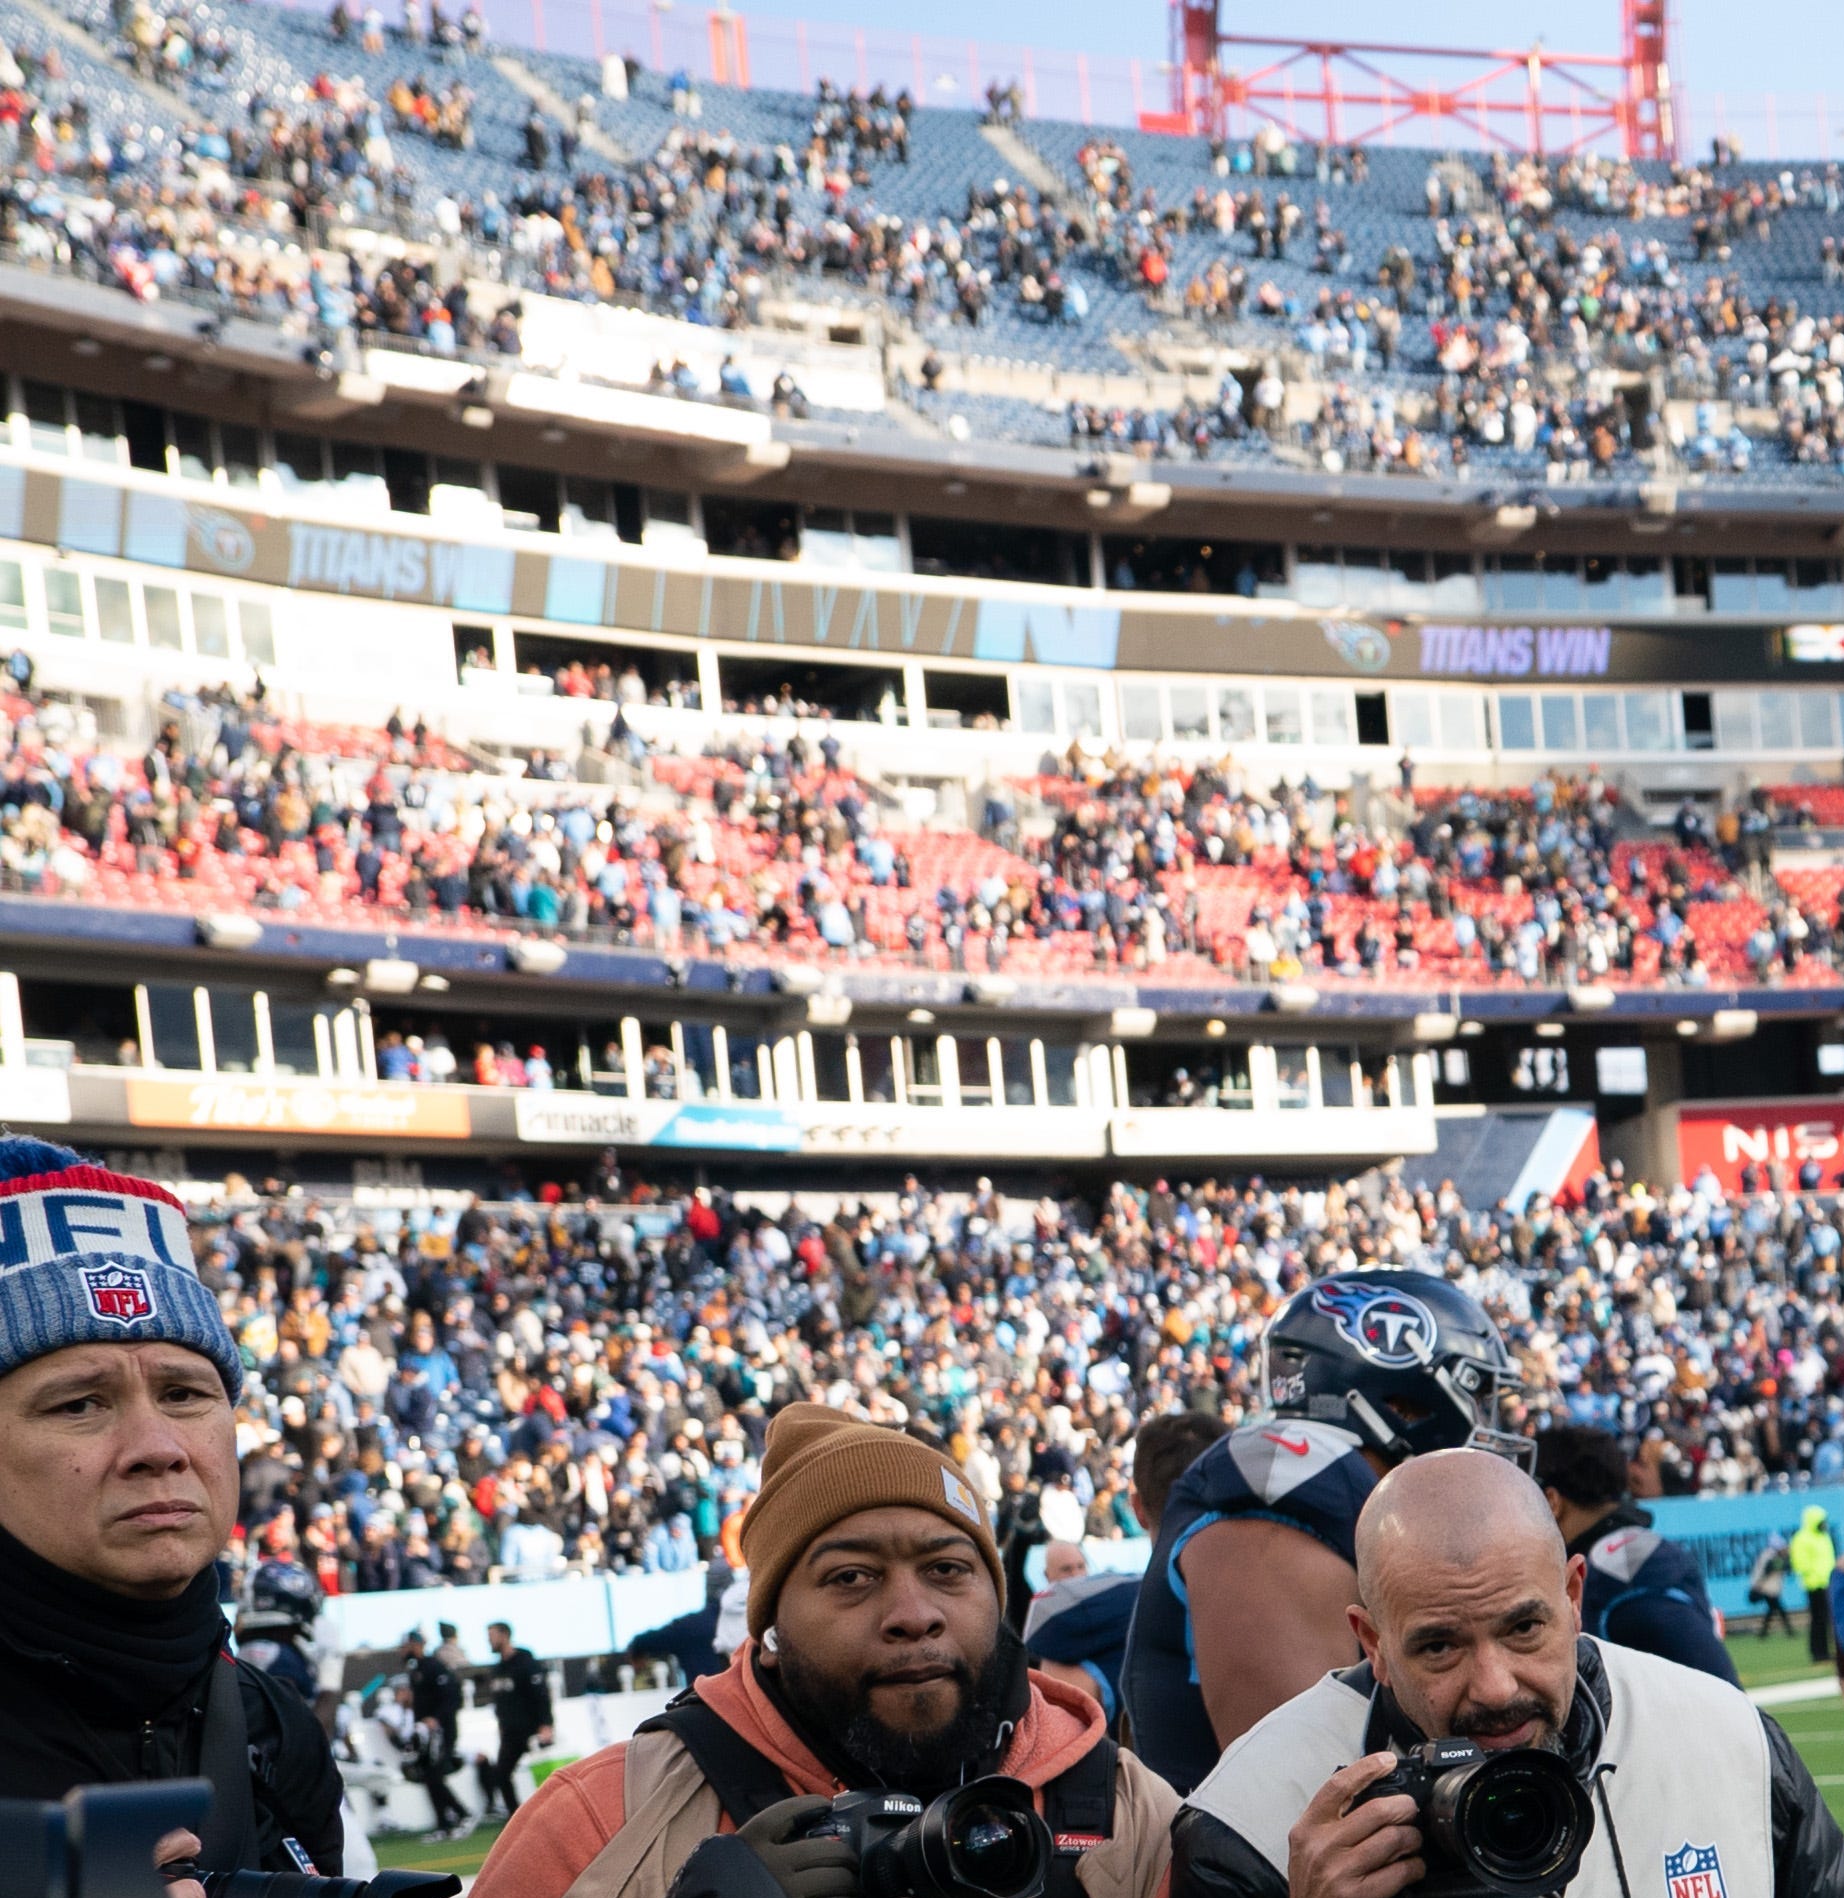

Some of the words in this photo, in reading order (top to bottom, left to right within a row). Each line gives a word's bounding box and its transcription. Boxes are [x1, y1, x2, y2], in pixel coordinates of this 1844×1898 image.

[1419, 626, 1533, 674] TITANS
[1537, 628, 1611, 675] WIN
[94, 1287, 148, 1319] NFL
[1440, 1747, 1474, 1760] SONY
[884, 1799, 922, 1813] Nikon
